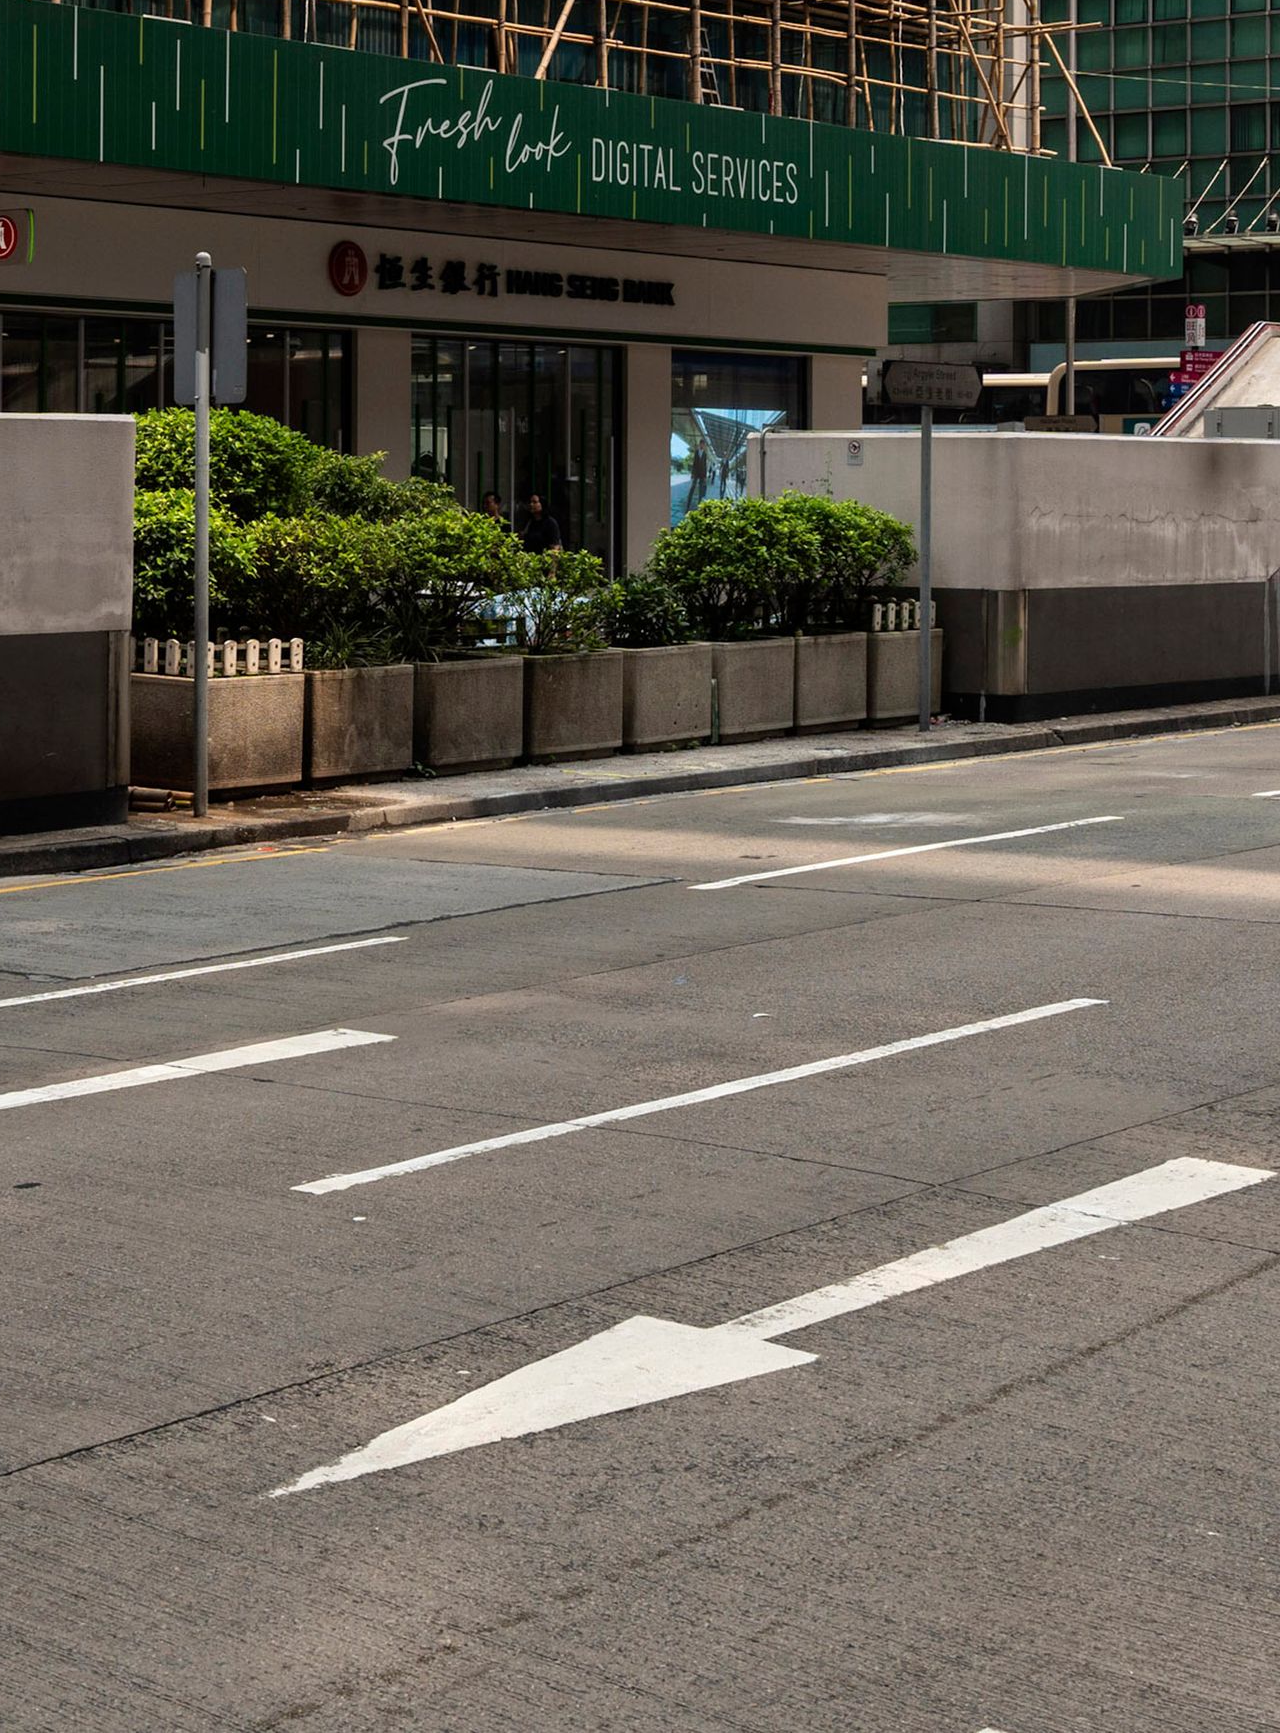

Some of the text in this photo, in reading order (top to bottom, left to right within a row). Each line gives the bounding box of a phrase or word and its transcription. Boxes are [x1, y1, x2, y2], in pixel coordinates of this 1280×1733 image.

[378, 78, 799, 205] Fresh look DIGITAL SERVICES
[374, 253, 676, 306] 恒生銀行 HANG SENG BANK
